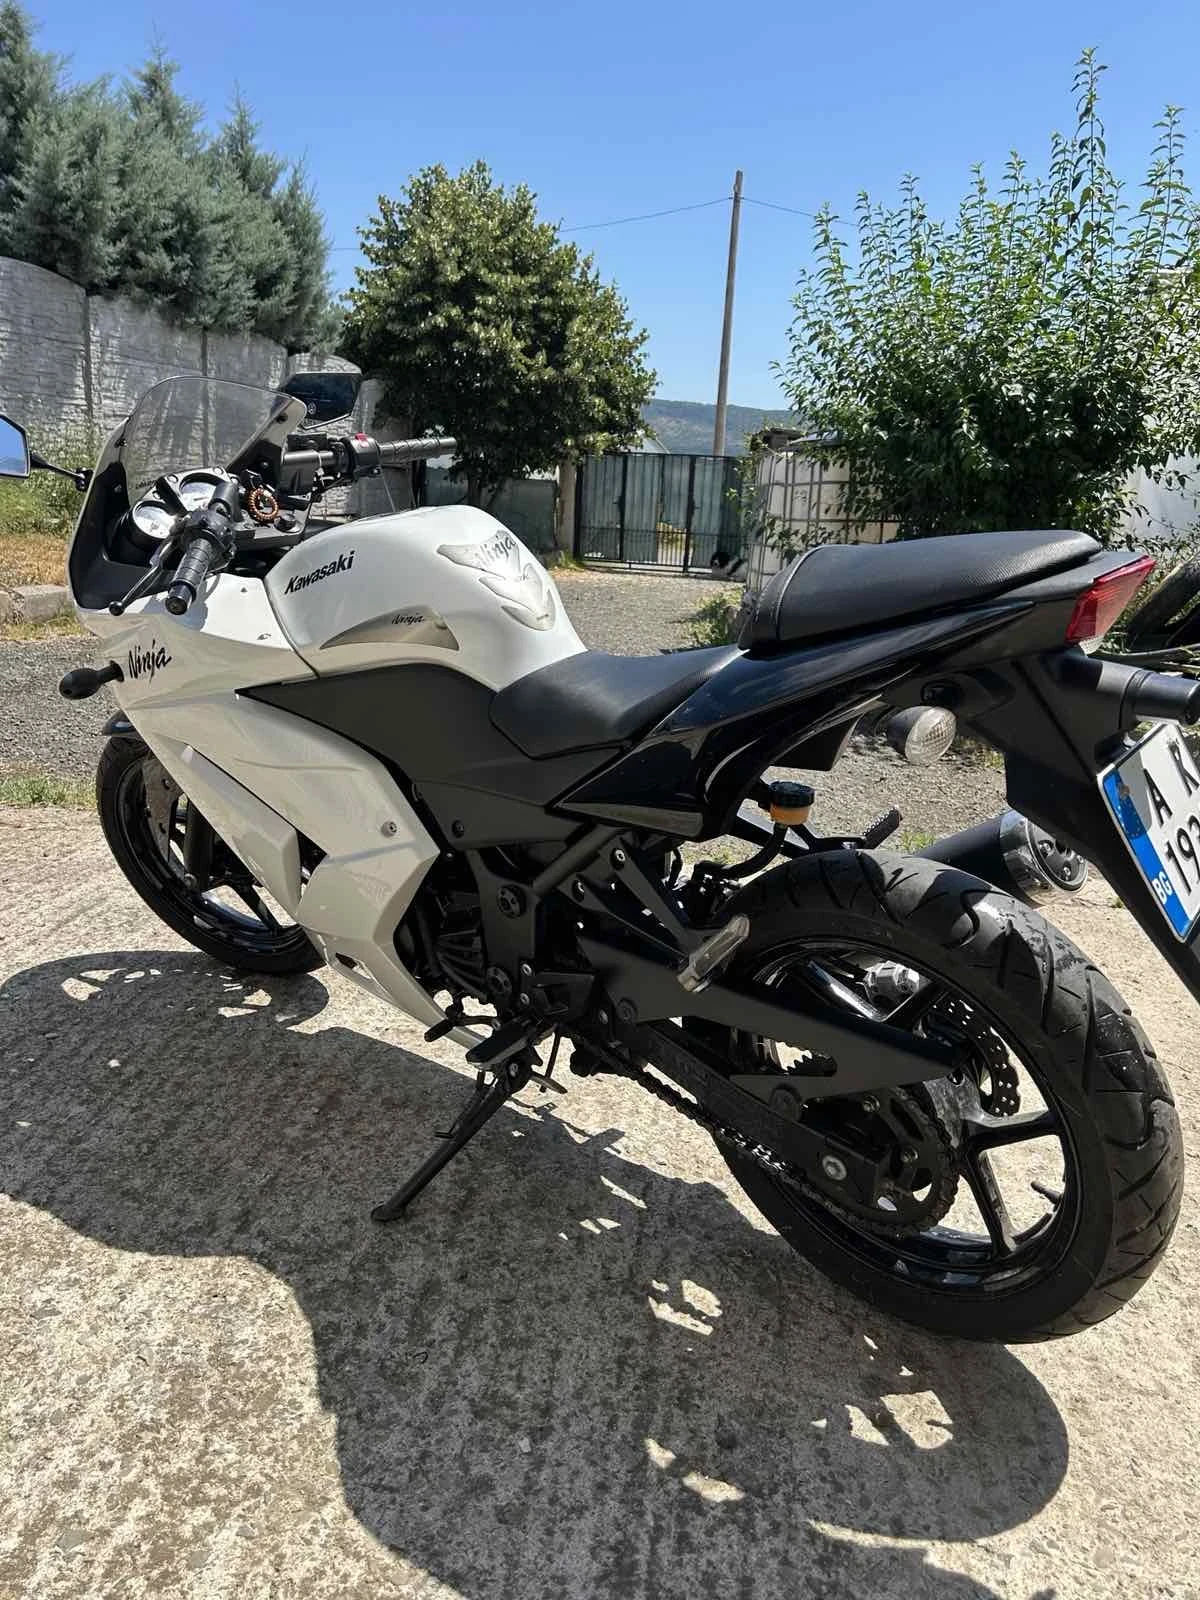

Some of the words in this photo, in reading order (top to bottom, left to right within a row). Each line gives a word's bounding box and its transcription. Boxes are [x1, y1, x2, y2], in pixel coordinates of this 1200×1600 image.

[284, 550, 355, 595] Kawasaki
[128, 639, 172, 682] Ninja
[1152, 871, 1173, 905] BG
